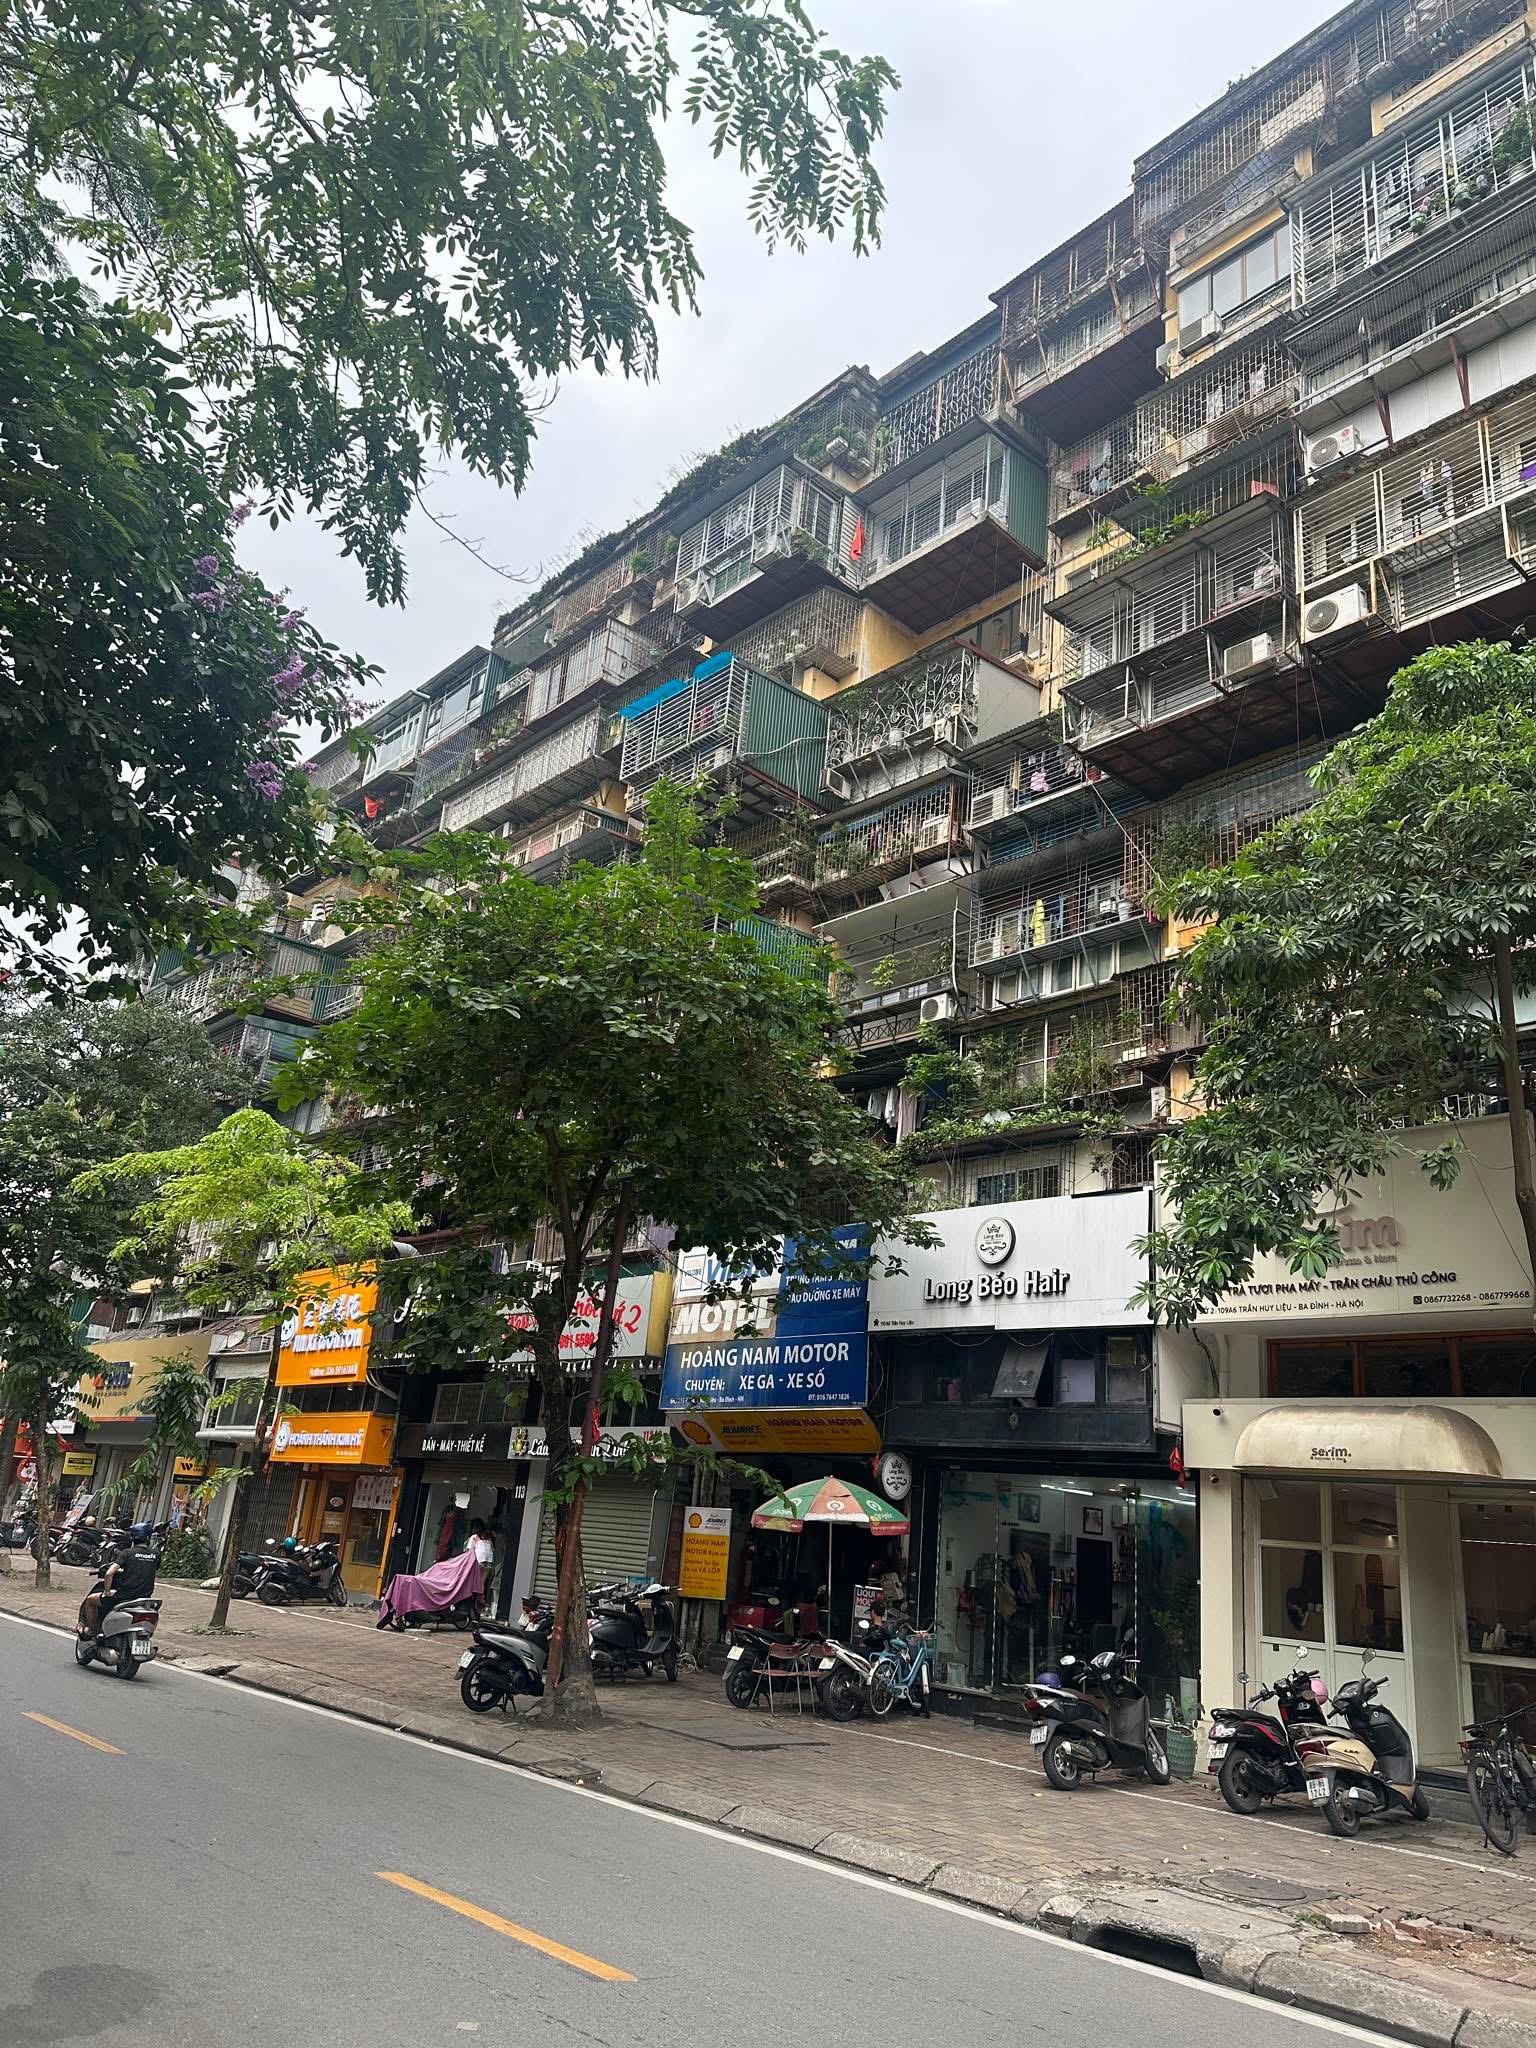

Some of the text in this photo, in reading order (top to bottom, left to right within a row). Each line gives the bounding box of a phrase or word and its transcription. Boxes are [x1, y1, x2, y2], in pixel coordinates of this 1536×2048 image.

[832, 1289, 842, 1299] XE
[843, 1285, 861, 1298] MÁY
[924, 1268, 1070, 1303] Long Béo Hair
[1248, 1283, 1274, 1295] TƯƠI
[1276, 1283, 1297, 1294] PHA
[1300, 1280, 1321, 1293] MÁY
[1330, 1276, 1359, 1290] TRÂN
[1362, 1274, 1392, 1288] CHÂU
[1395, 1272, 1418, 1286] THỦ
[1421, 1271, 1457, 1284] CÔNG
[1276, 1303, 1292, 1312] LIỆU
[1310, 1302, 1329, 1310] ĐÌNH
[1336, 1300, 1347, 1309] HÀ
[1349, 1299, 1364, 1309] NỘI
[1424, 1294, 1471, 1304] 0867732268
[1479, 1290, 1530, 1301] 0867799668
[624, 1304, 642, 1334] 2
[672, 1297, 771, 1335] MOTUL
[681, 1342, 849, 1368] HOÀNG NAM MOTOR
[685, 1376, 726, 1391] CHUYÊN:
[739, 1375, 755, 1390] XE
[757, 1374, 775, 1389] GA
[786, 1373, 804, 1388] XE
[806, 1367, 825, 1388] SỐ
[422, 1436, 436, 1451] BÁN
[440, 1440, 454, 1452] MAY
[475, 1433, 487, 1452] KẾ
[515, 1485, 526, 1499] 113
[711, 1539, 726, 1547] NAM
